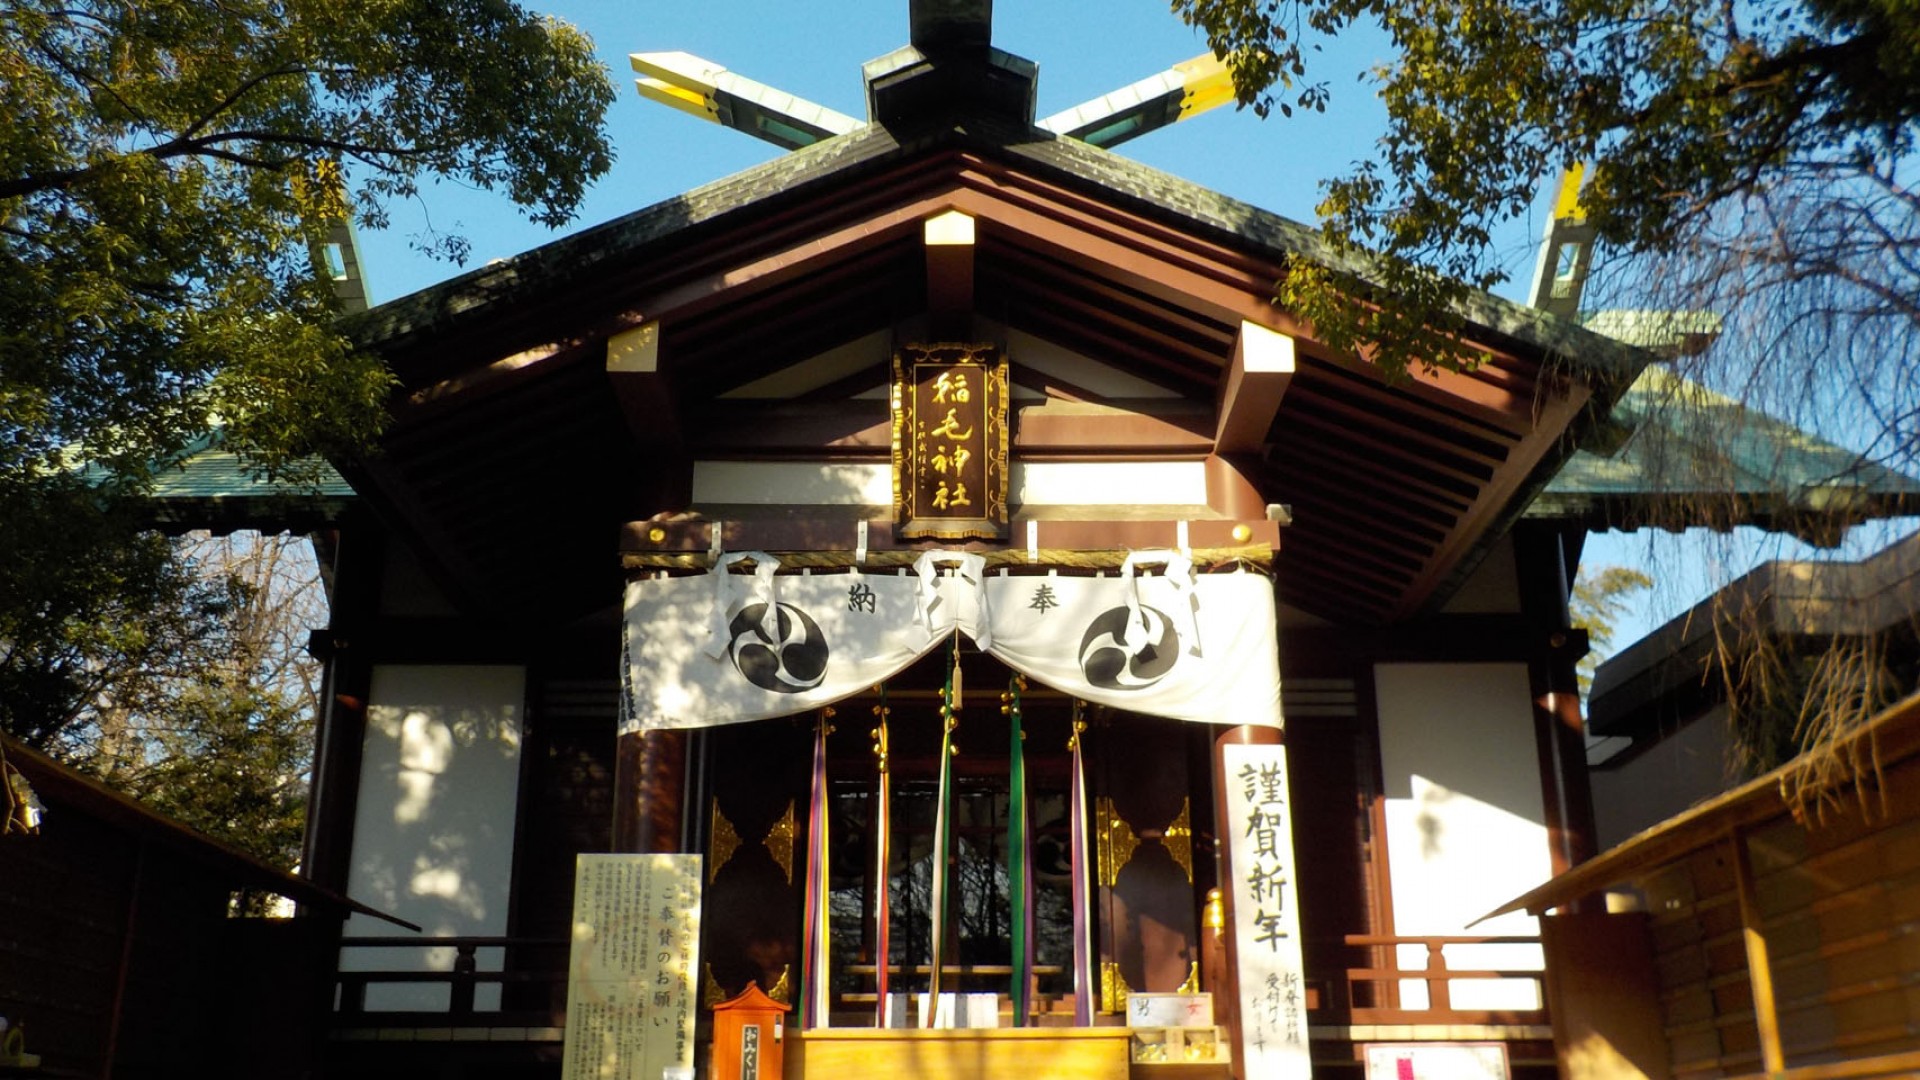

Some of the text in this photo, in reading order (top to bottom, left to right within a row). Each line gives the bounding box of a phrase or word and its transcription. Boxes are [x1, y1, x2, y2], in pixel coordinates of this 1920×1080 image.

[931, 372, 973, 510] 稲毛神社
[848, 583, 876, 614] 納
[1029, 583, 1060, 614] 奉
[1238, 761, 1288, 952] 謹賀新年
[653, 887, 674, 1027] ご奉賛のお願い
